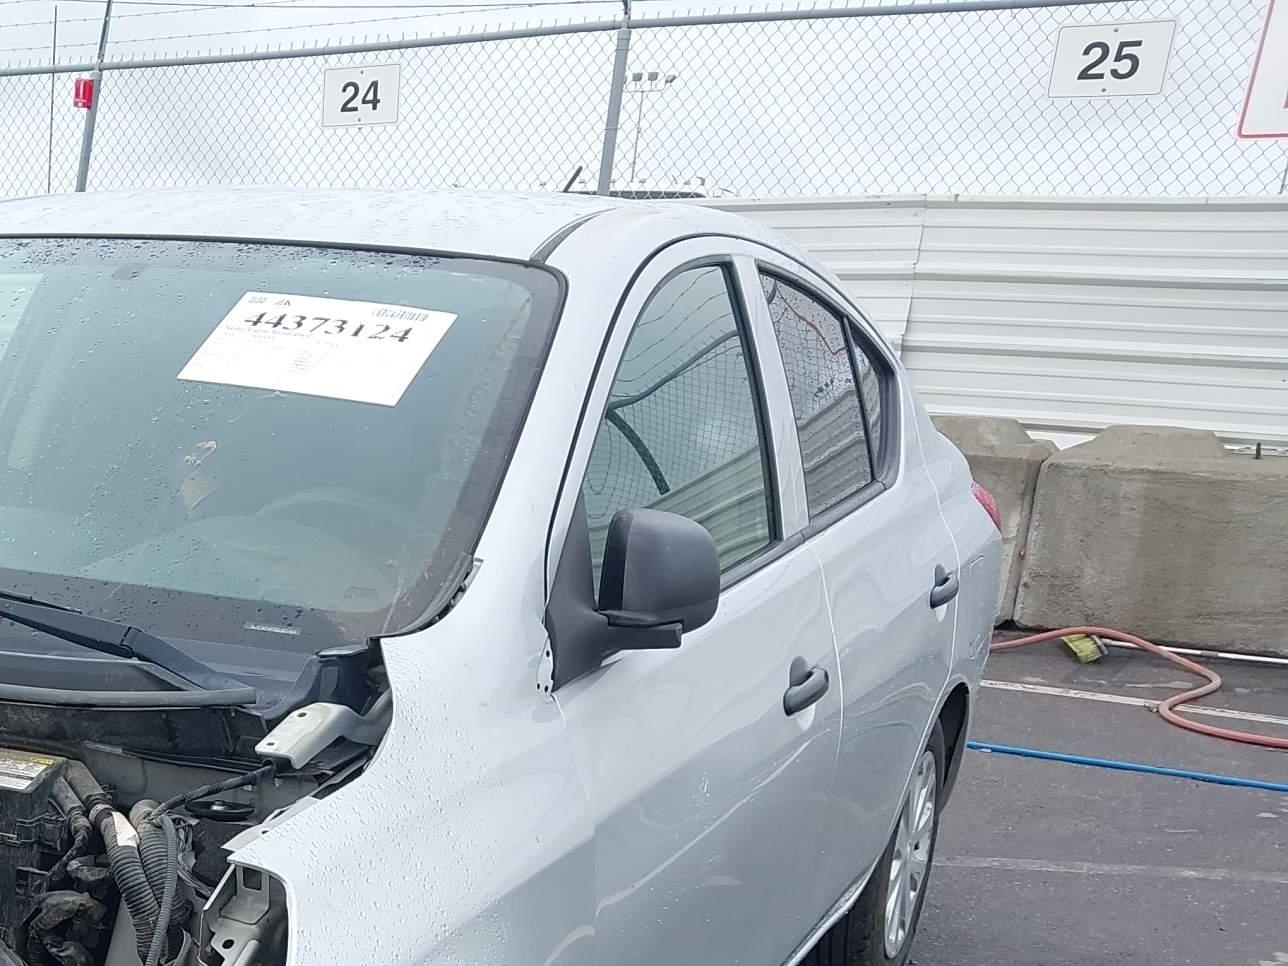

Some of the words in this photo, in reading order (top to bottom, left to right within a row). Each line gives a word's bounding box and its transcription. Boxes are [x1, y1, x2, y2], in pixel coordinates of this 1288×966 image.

[1077, 40, 1143, 80] 25
[340, 80, 381, 112] 24
[244, 311, 413, 343] 44373124
